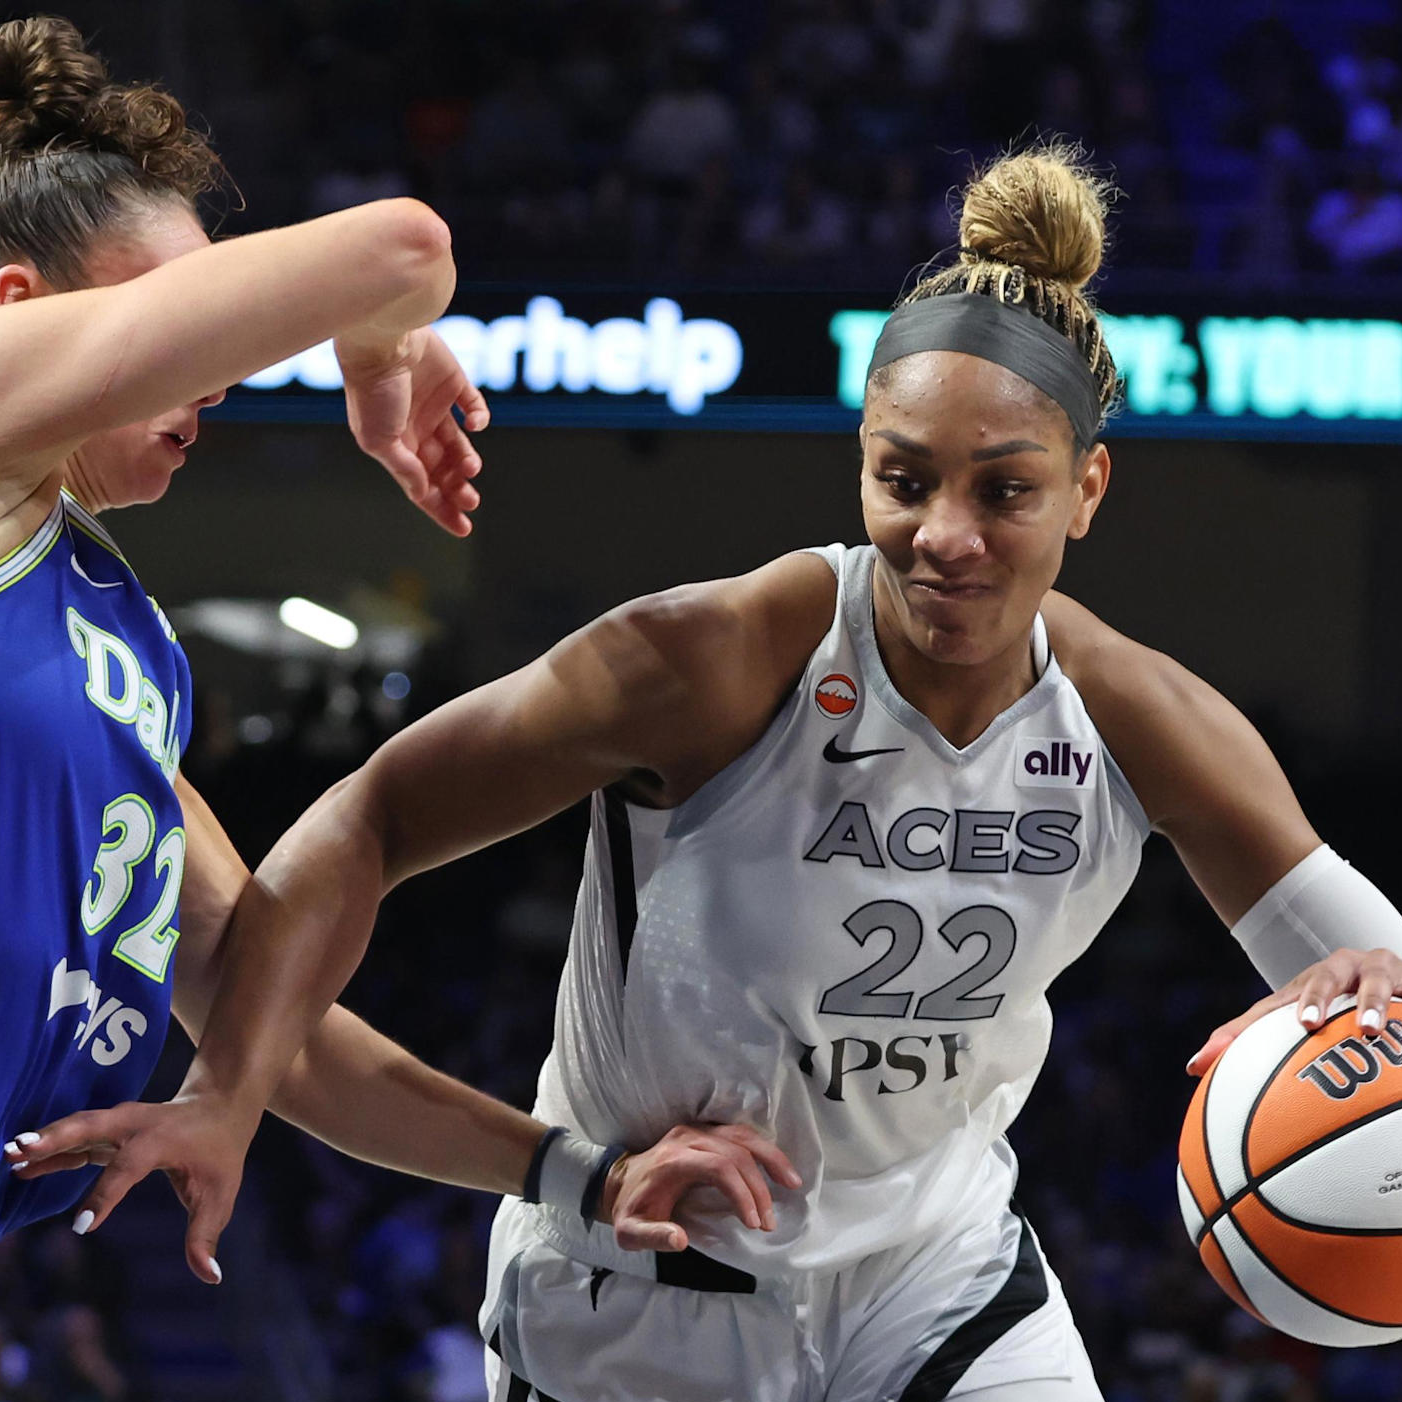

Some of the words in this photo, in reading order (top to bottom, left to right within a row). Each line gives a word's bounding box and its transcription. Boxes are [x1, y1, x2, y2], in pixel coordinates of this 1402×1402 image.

[1023, 742, 1094, 786] ally
[80, 792, 187, 984] 32
[802, 801, 1083, 876] ACES
[818, 898, 1018, 1021] 22
